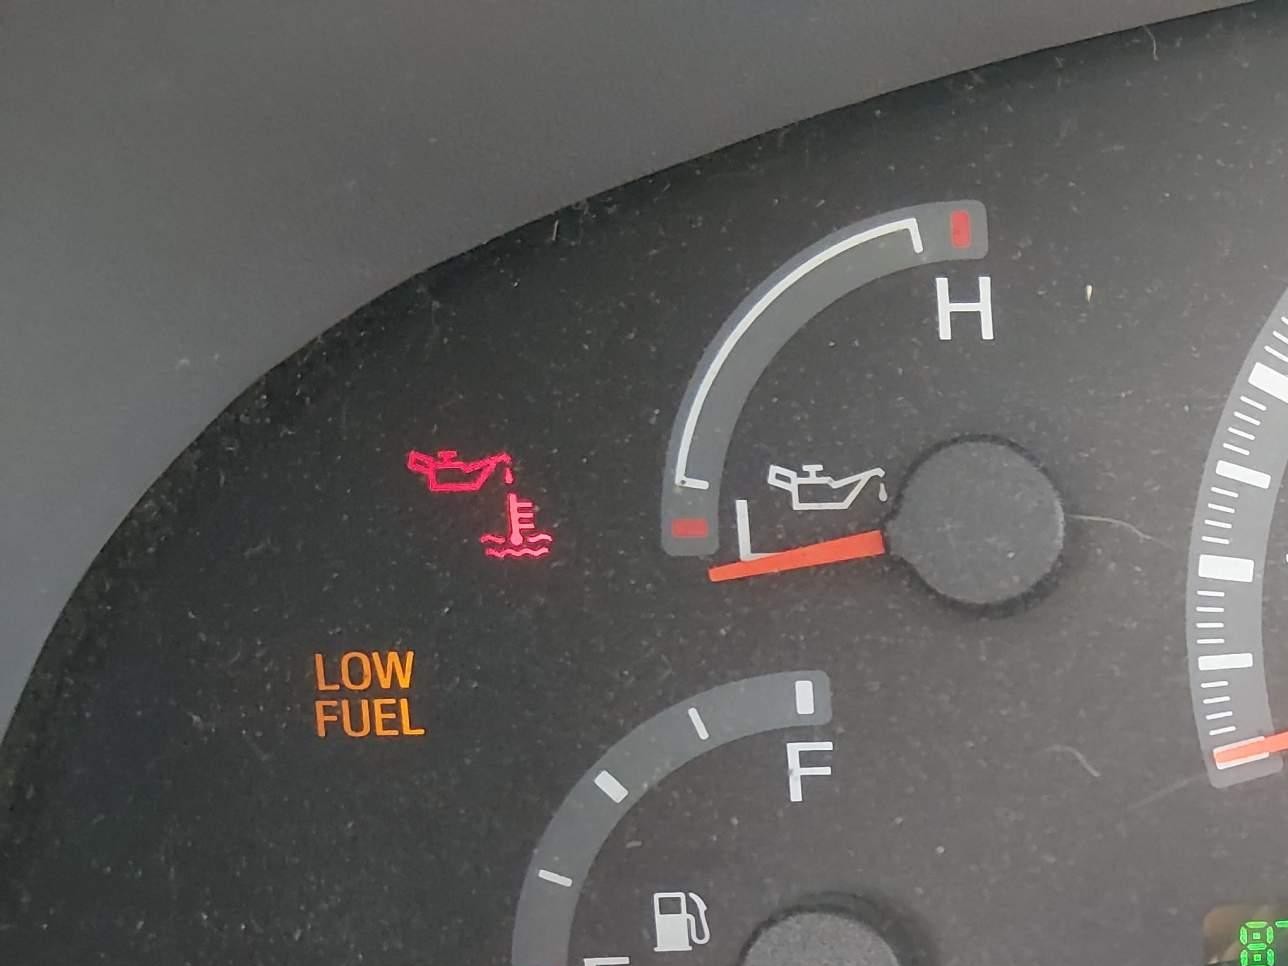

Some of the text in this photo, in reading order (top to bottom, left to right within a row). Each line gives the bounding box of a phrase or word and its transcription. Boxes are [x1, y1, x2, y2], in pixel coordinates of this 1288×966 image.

[935, 276, 994, 341] H
[736, 499, 776, 561] L
[314, 650, 414, 691] LOW
[314, 698, 425, 738] FUEL
[786, 741, 834, 802] F
